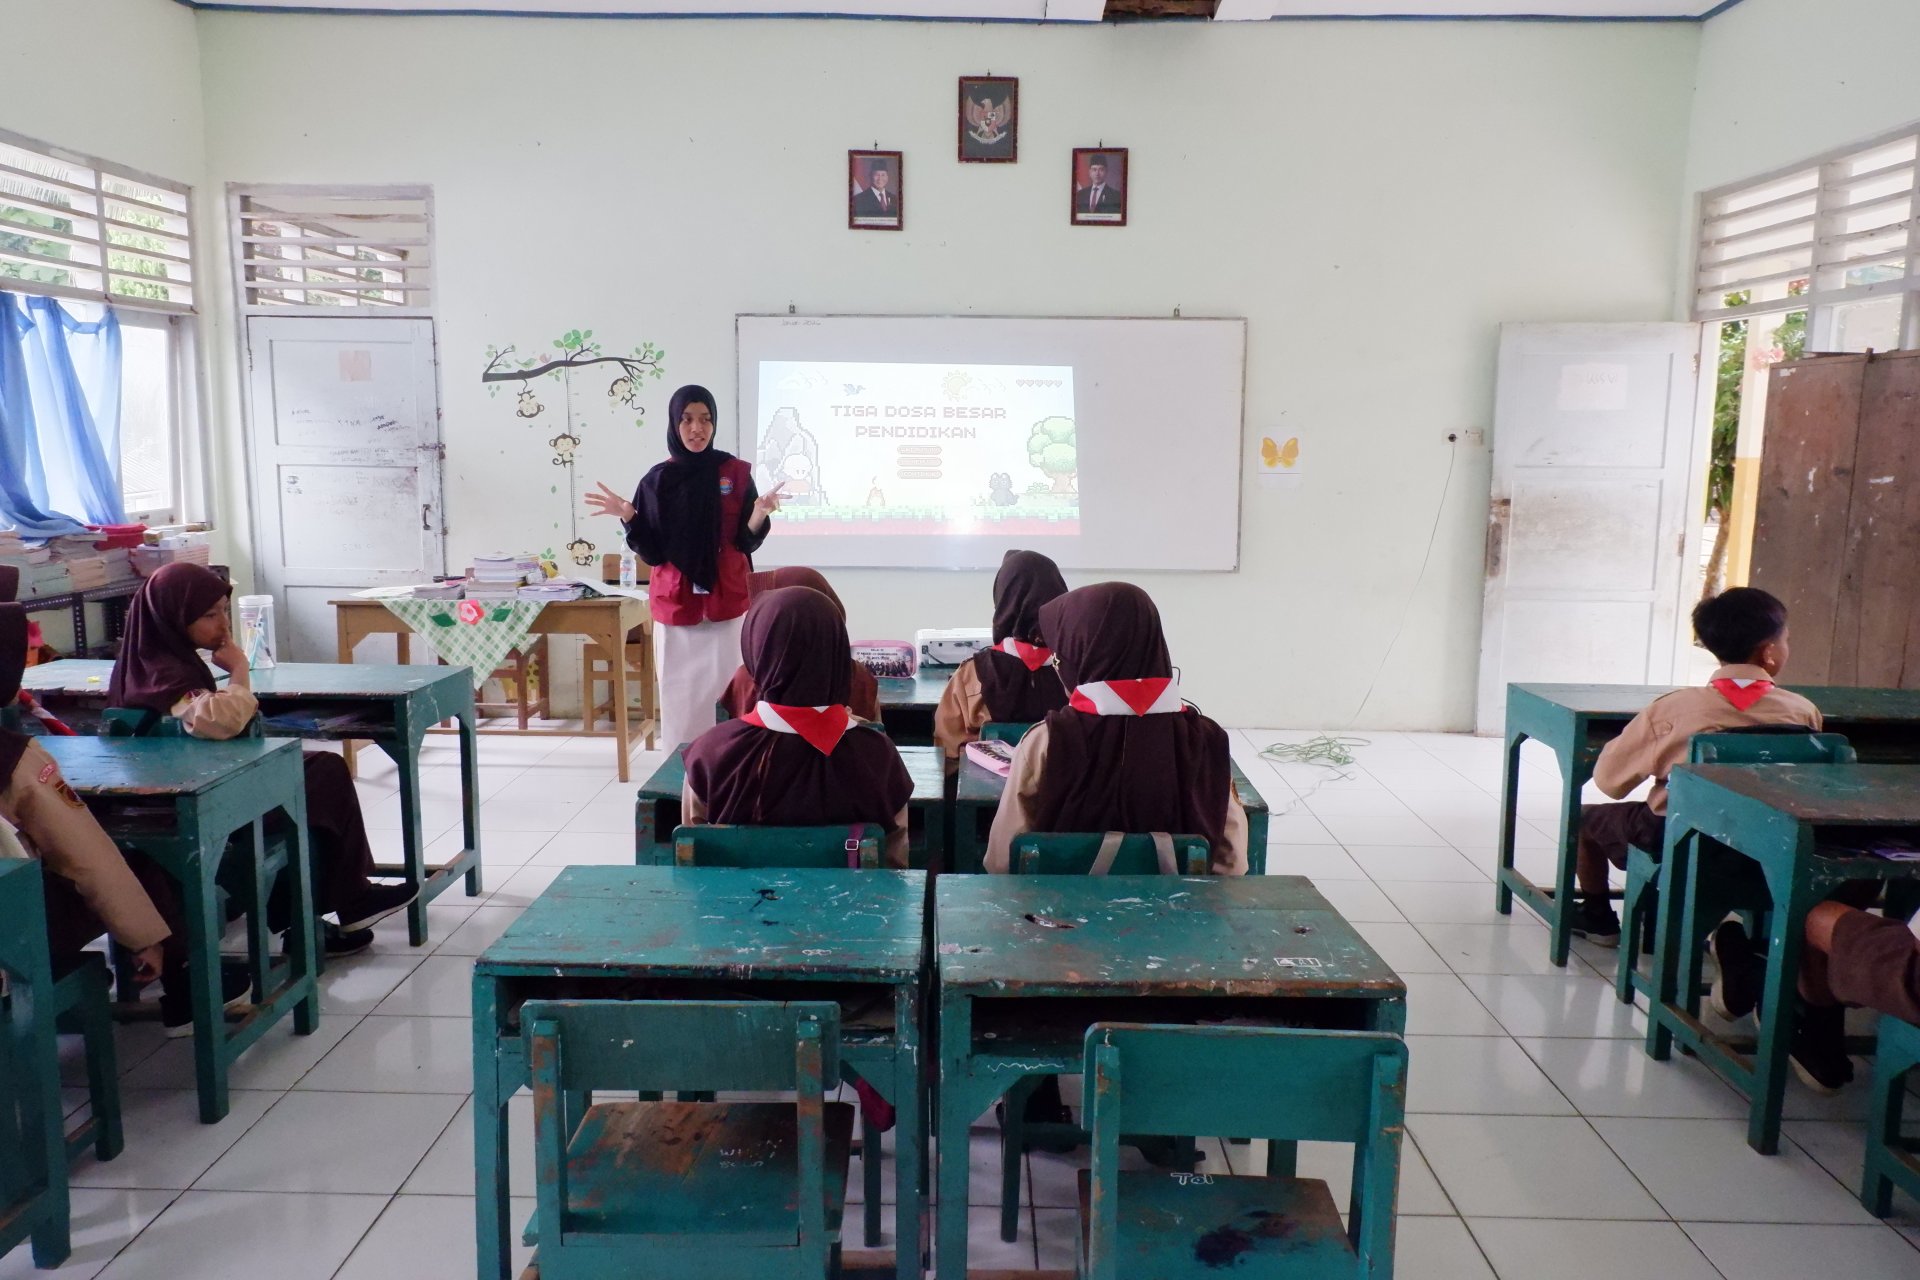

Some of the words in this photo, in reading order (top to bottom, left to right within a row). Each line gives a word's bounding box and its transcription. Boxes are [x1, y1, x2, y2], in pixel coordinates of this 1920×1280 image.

[830, 405, 878, 417] TIGA
[885, 405, 936, 418] DOSA
[943, 406, 1007, 419] BESAR
[855, 425, 976, 439] PENDIDIKAN
